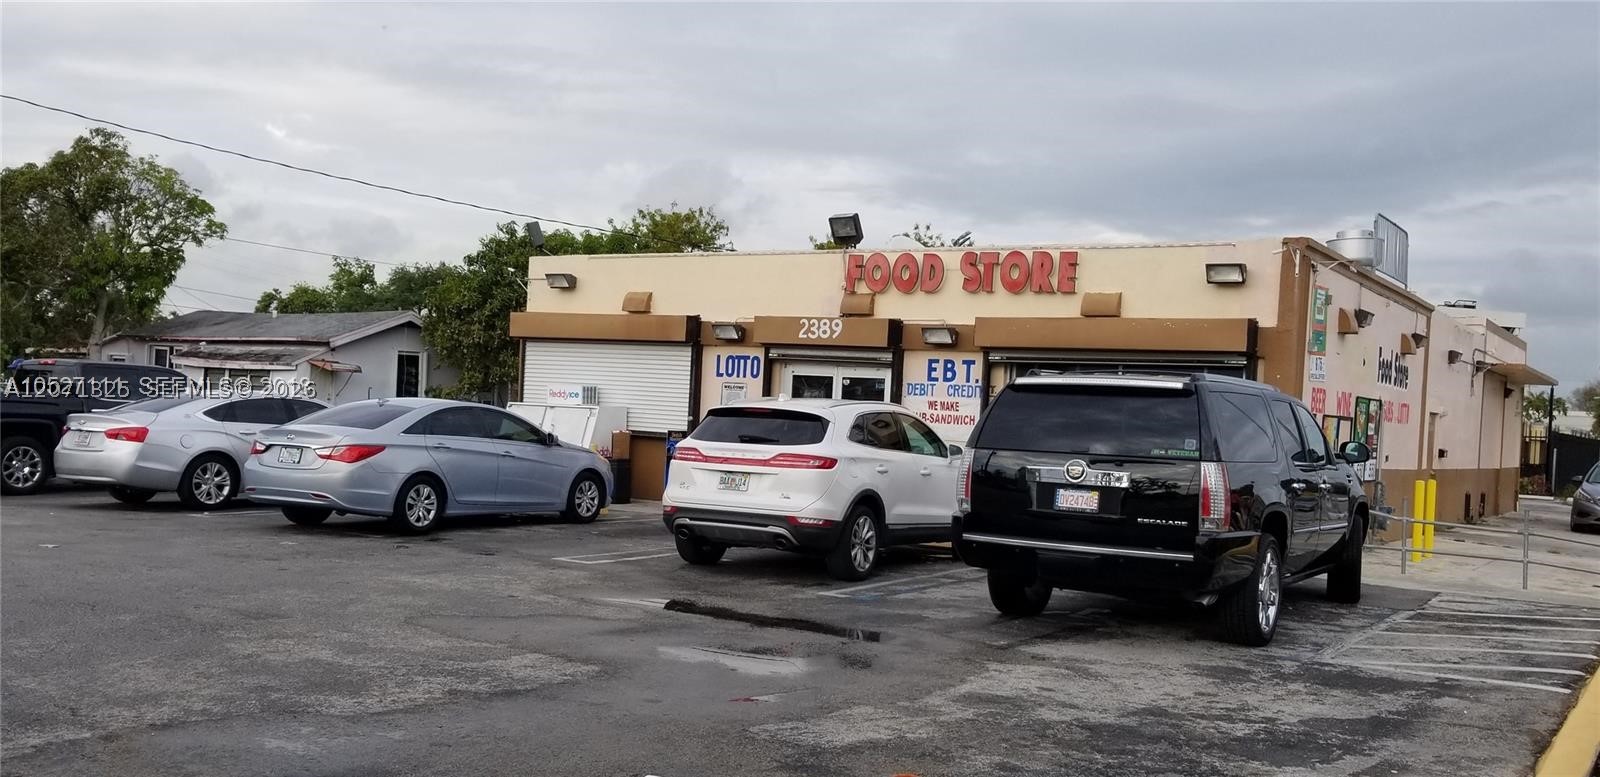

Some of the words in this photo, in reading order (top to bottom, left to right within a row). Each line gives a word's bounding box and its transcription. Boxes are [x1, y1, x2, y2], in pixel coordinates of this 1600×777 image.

[846, 252, 945, 294] FOOD
[960, 250, 1080, 294] STORE
[798, 318, 843, 339] 2389
[716, 354, 761, 379] LOTTO
[1377, 346, 1394, 385] Food
[906, 383, 936, 397] DEBIT
[1311, 386, 1327, 414] BEER
[1336, 391, 1352, 416] WINE
[928, 400, 938, 411] WE
[940, 400, 960, 412] MAKE
[1137, 517, 1188, 527] ESCALADE
